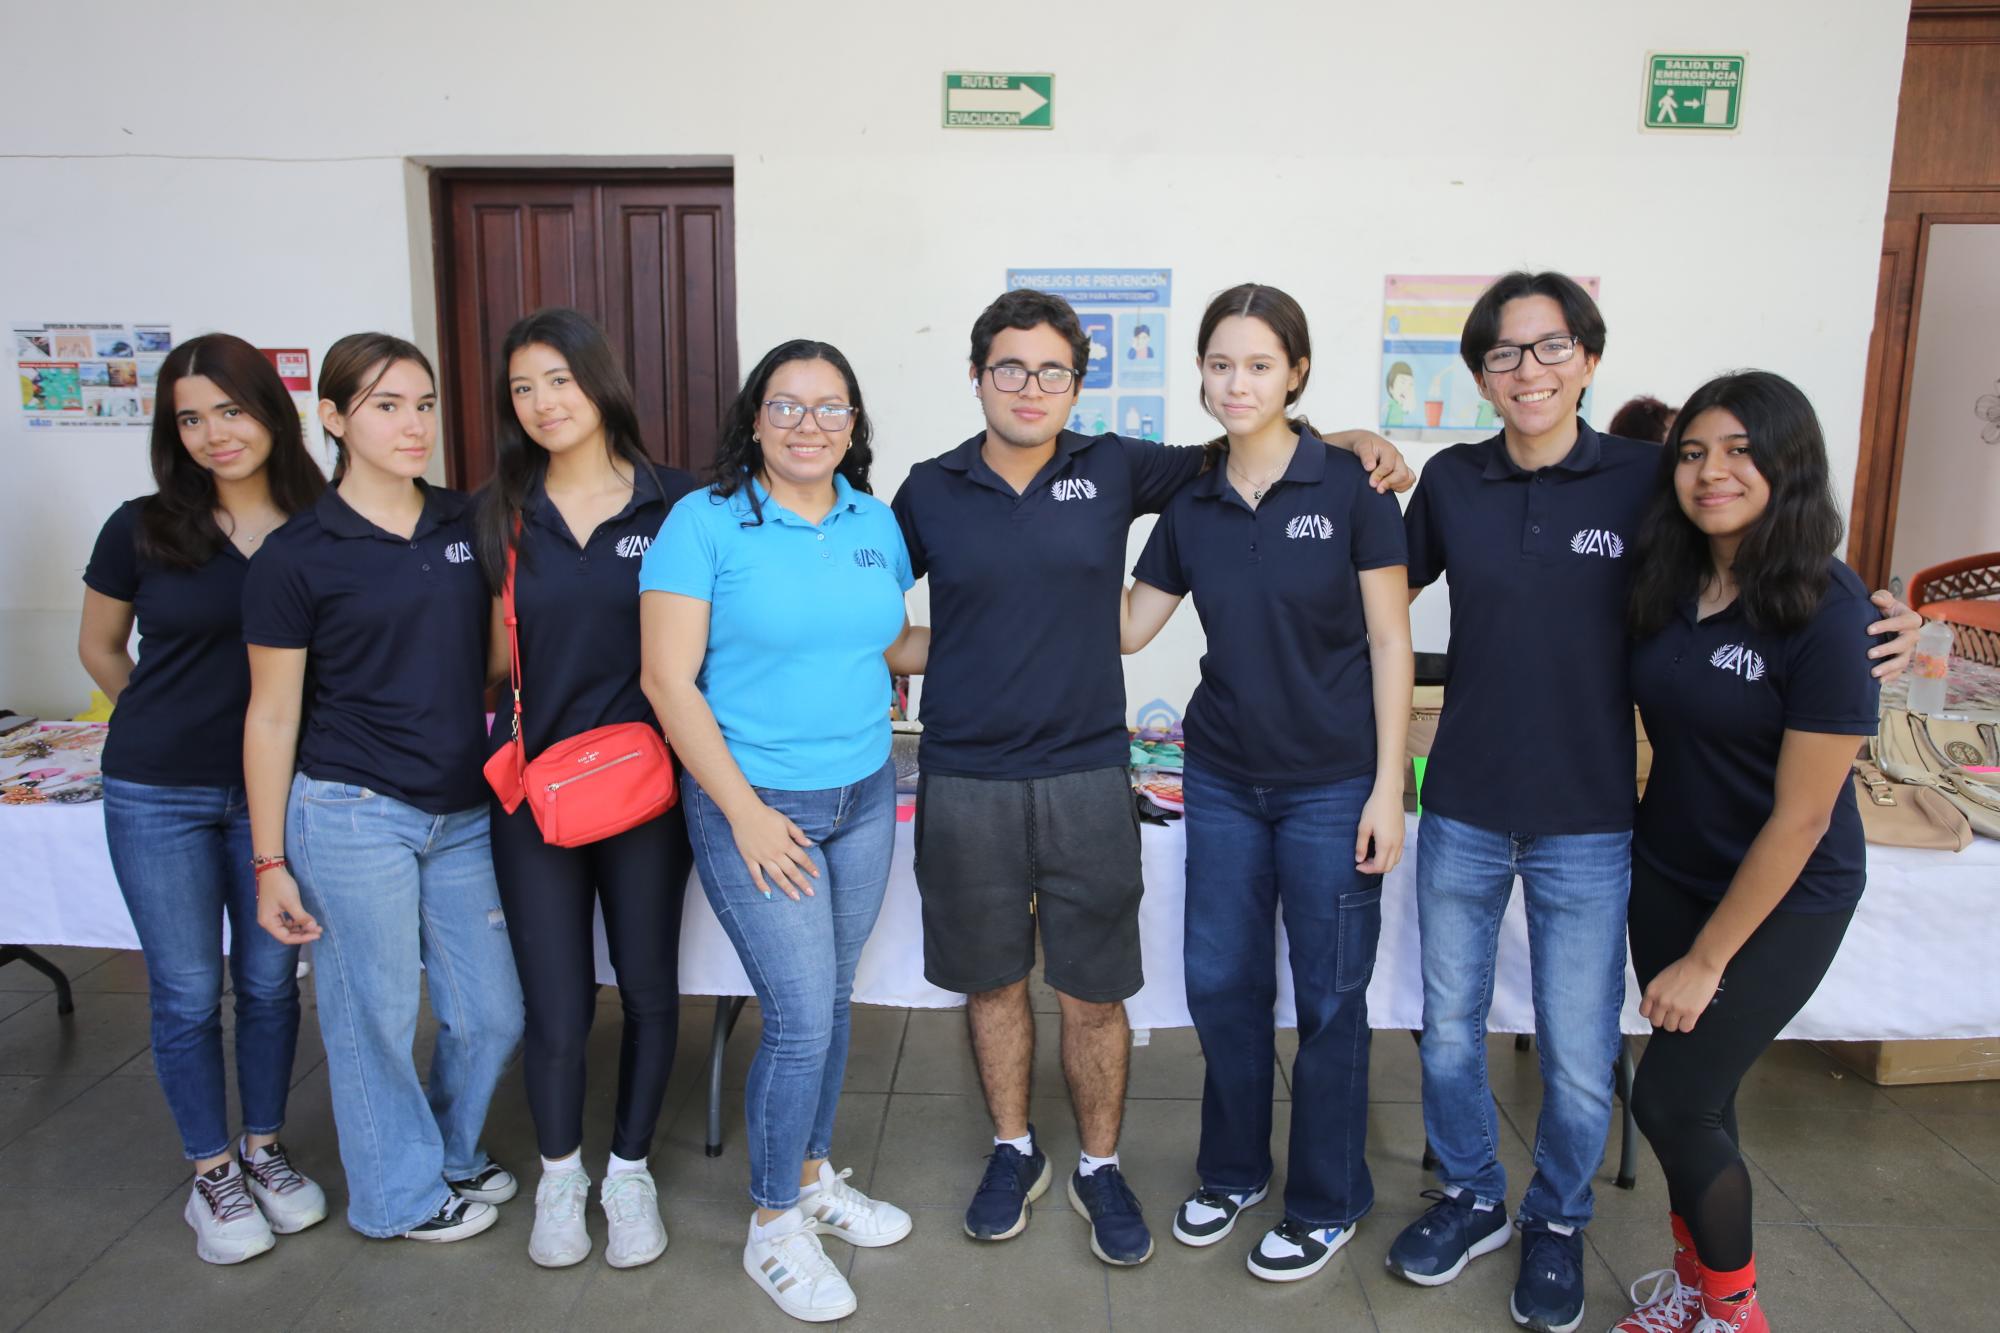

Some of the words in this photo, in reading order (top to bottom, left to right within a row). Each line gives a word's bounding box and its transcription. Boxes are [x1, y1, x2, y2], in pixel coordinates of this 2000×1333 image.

[1665, 60, 1709, 70] SALIDA
[1713, 61, 1730, 70] DE
[1655, 70, 1737, 80] EMERGENCIA
[961, 76, 991, 88] RUTA
[992, 76, 1008, 88] DE
[1011, 274, 1073, 288] CONSEJOS
[1075, 274, 1090, 287] DE
